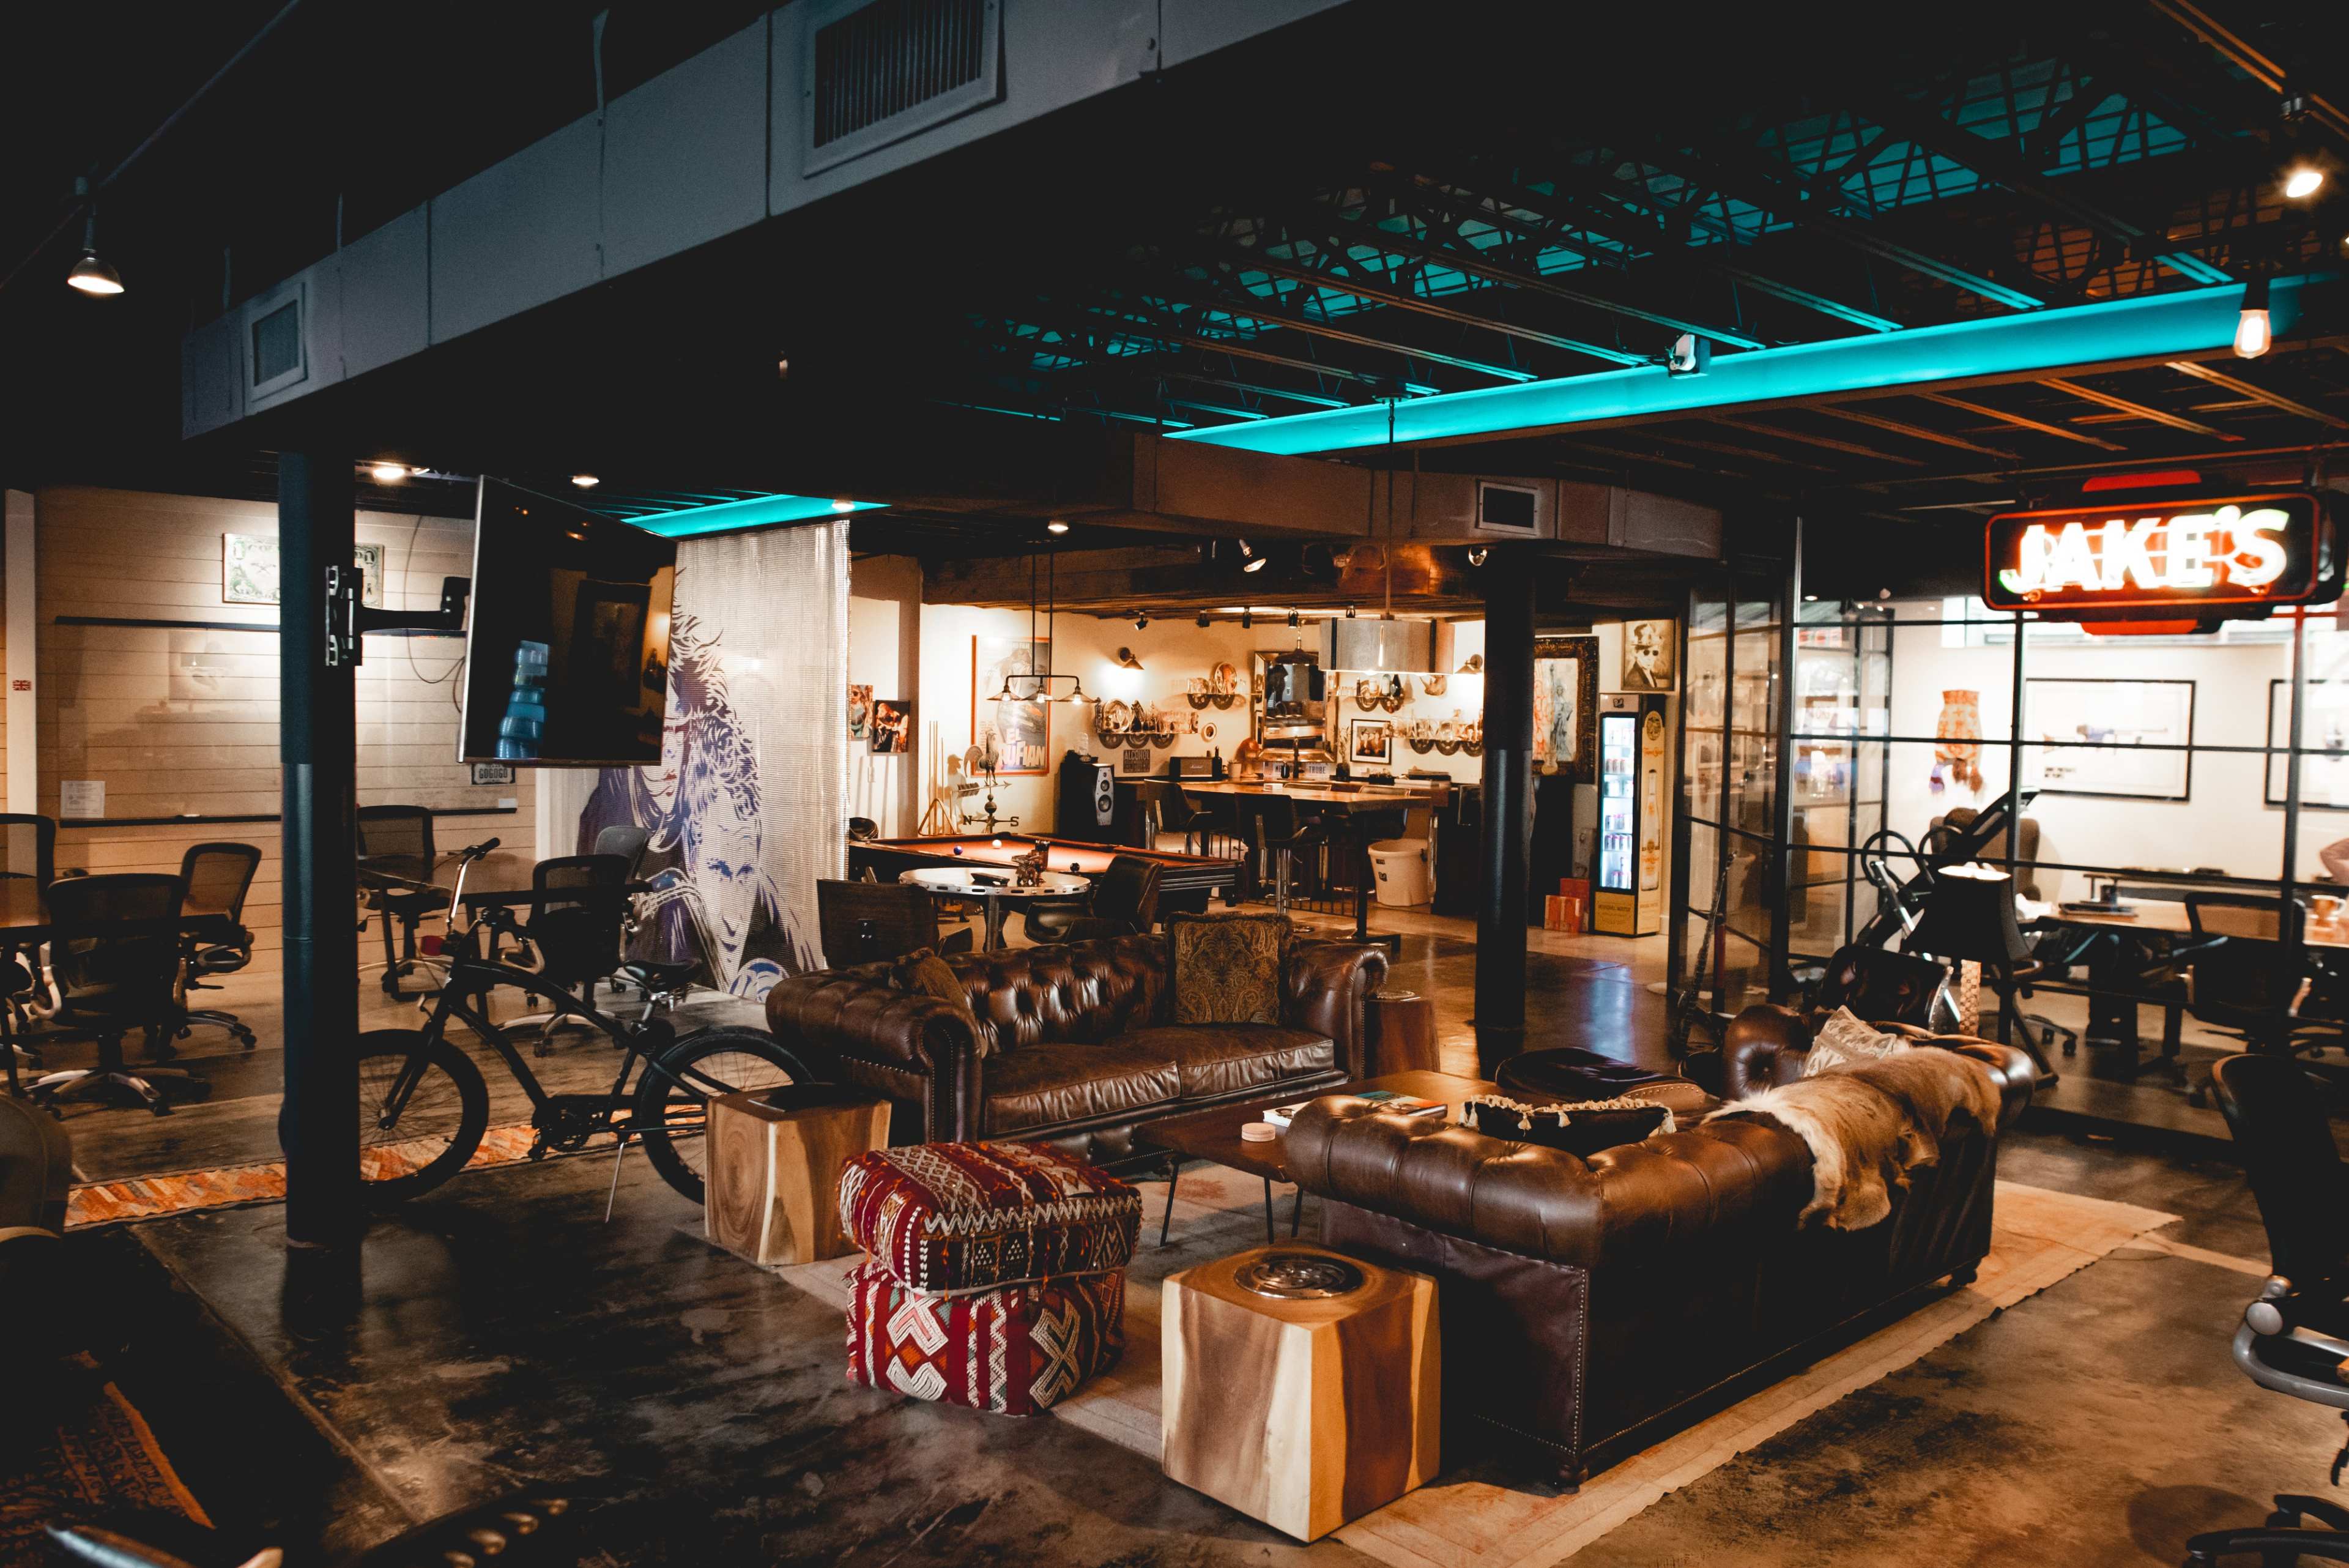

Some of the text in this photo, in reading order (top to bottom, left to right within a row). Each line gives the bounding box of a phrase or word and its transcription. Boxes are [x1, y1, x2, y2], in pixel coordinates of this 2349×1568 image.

[1999, 505, 2290, 594] JAKE'S
[1124, 750, 1150, 760] ALCOHOL
[963, 815, 972, 825] N
[1010, 816, 1019, 827] S
